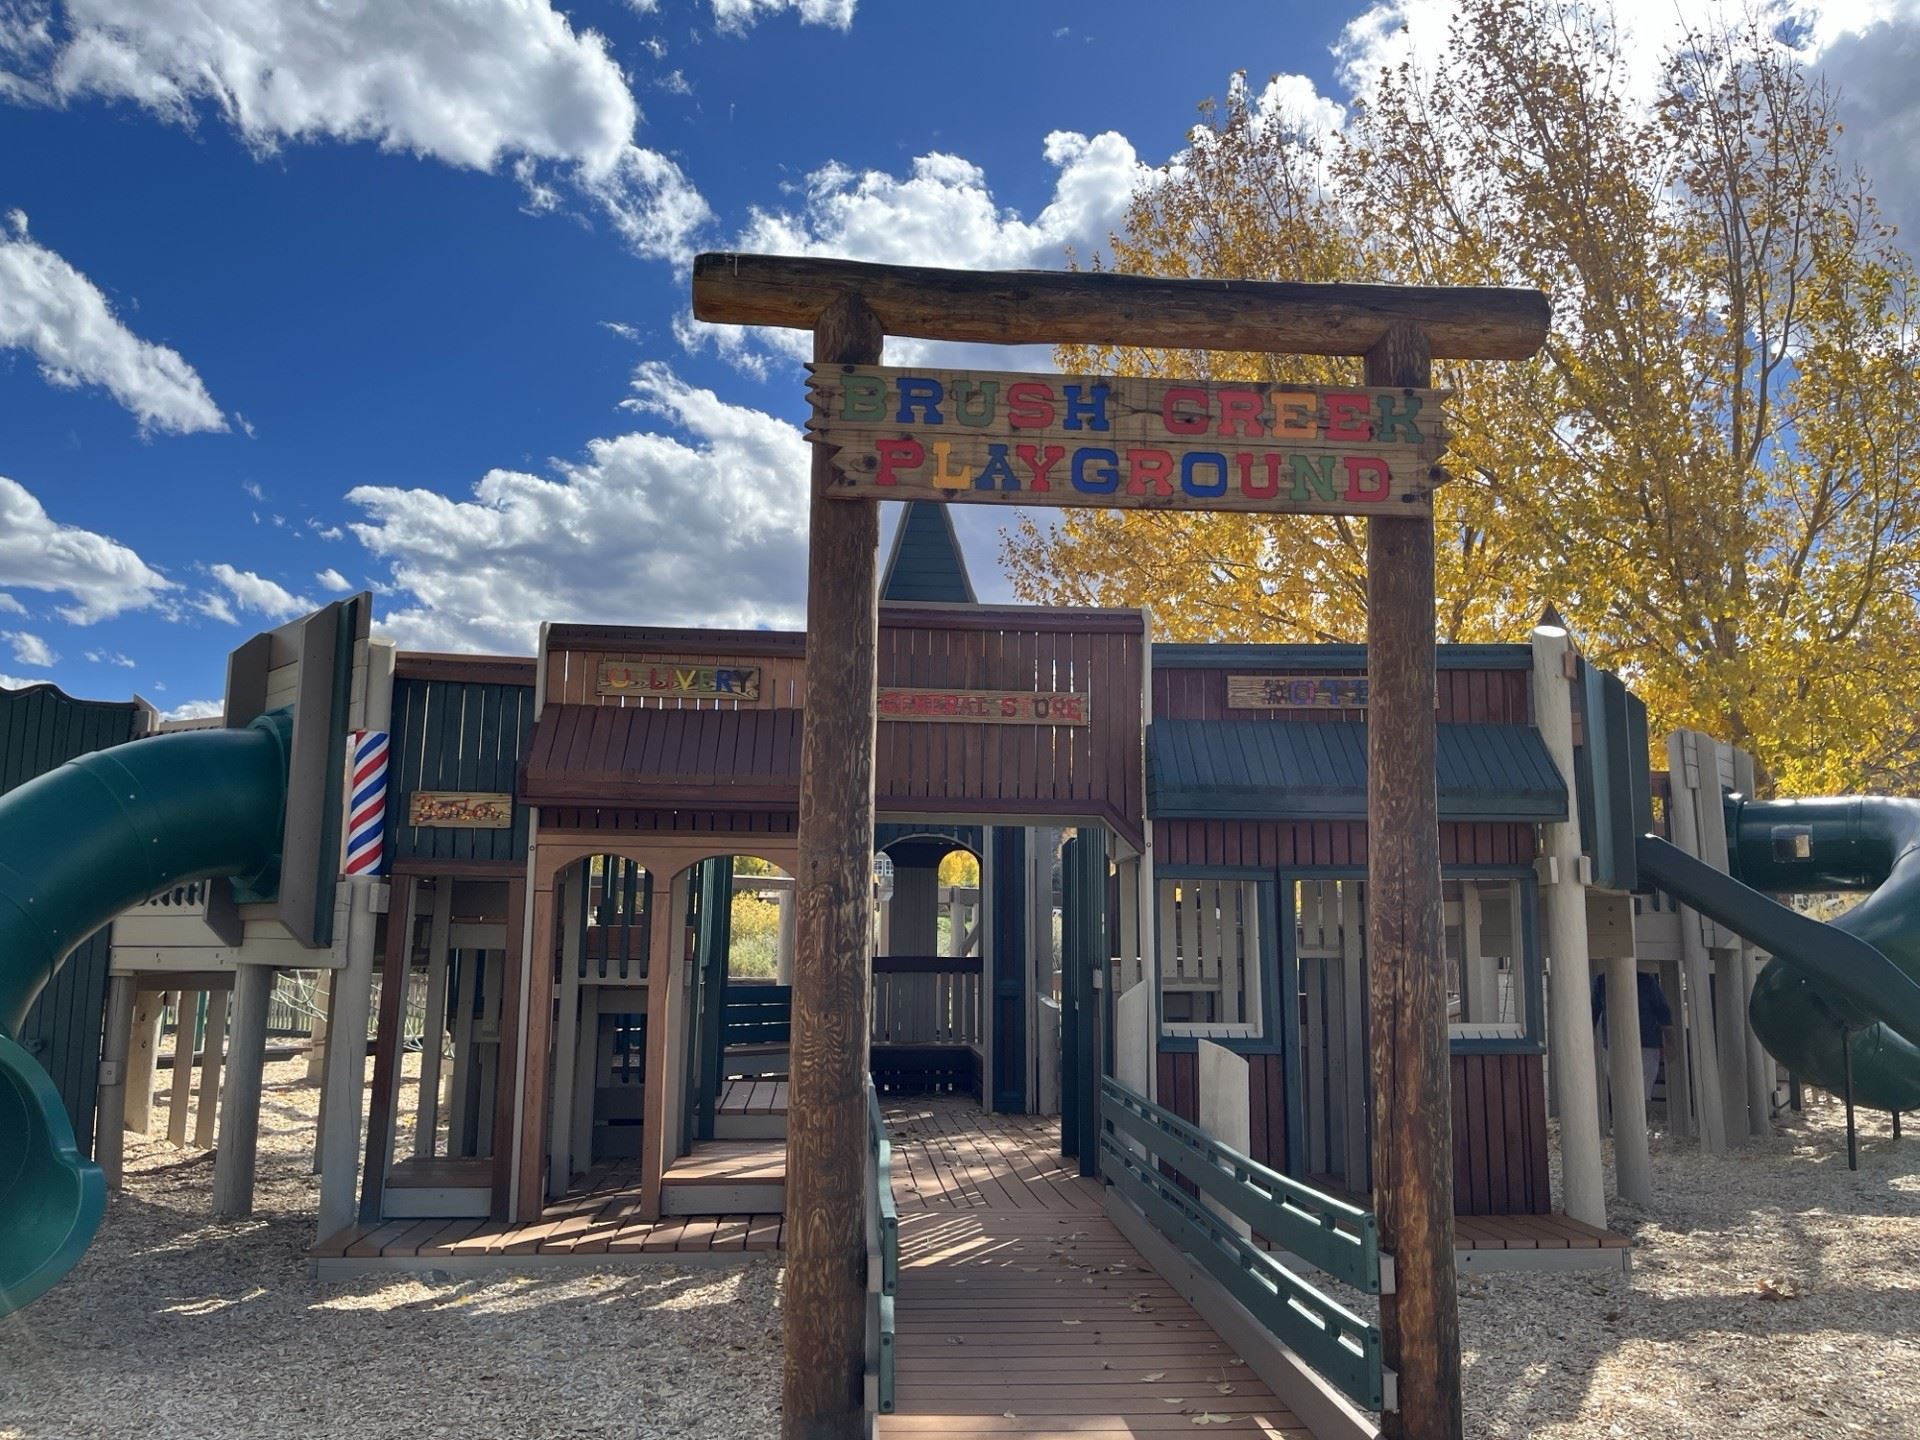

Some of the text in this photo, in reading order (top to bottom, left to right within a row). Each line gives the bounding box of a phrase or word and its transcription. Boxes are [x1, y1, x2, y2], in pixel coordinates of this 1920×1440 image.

[838, 373, 1423, 443] BRUSH CREEK
[875, 439, 1391, 501] PLAYGROUND
[650, 668, 753, 694] LIVERY
[1001, 696, 1083, 721] STORE
